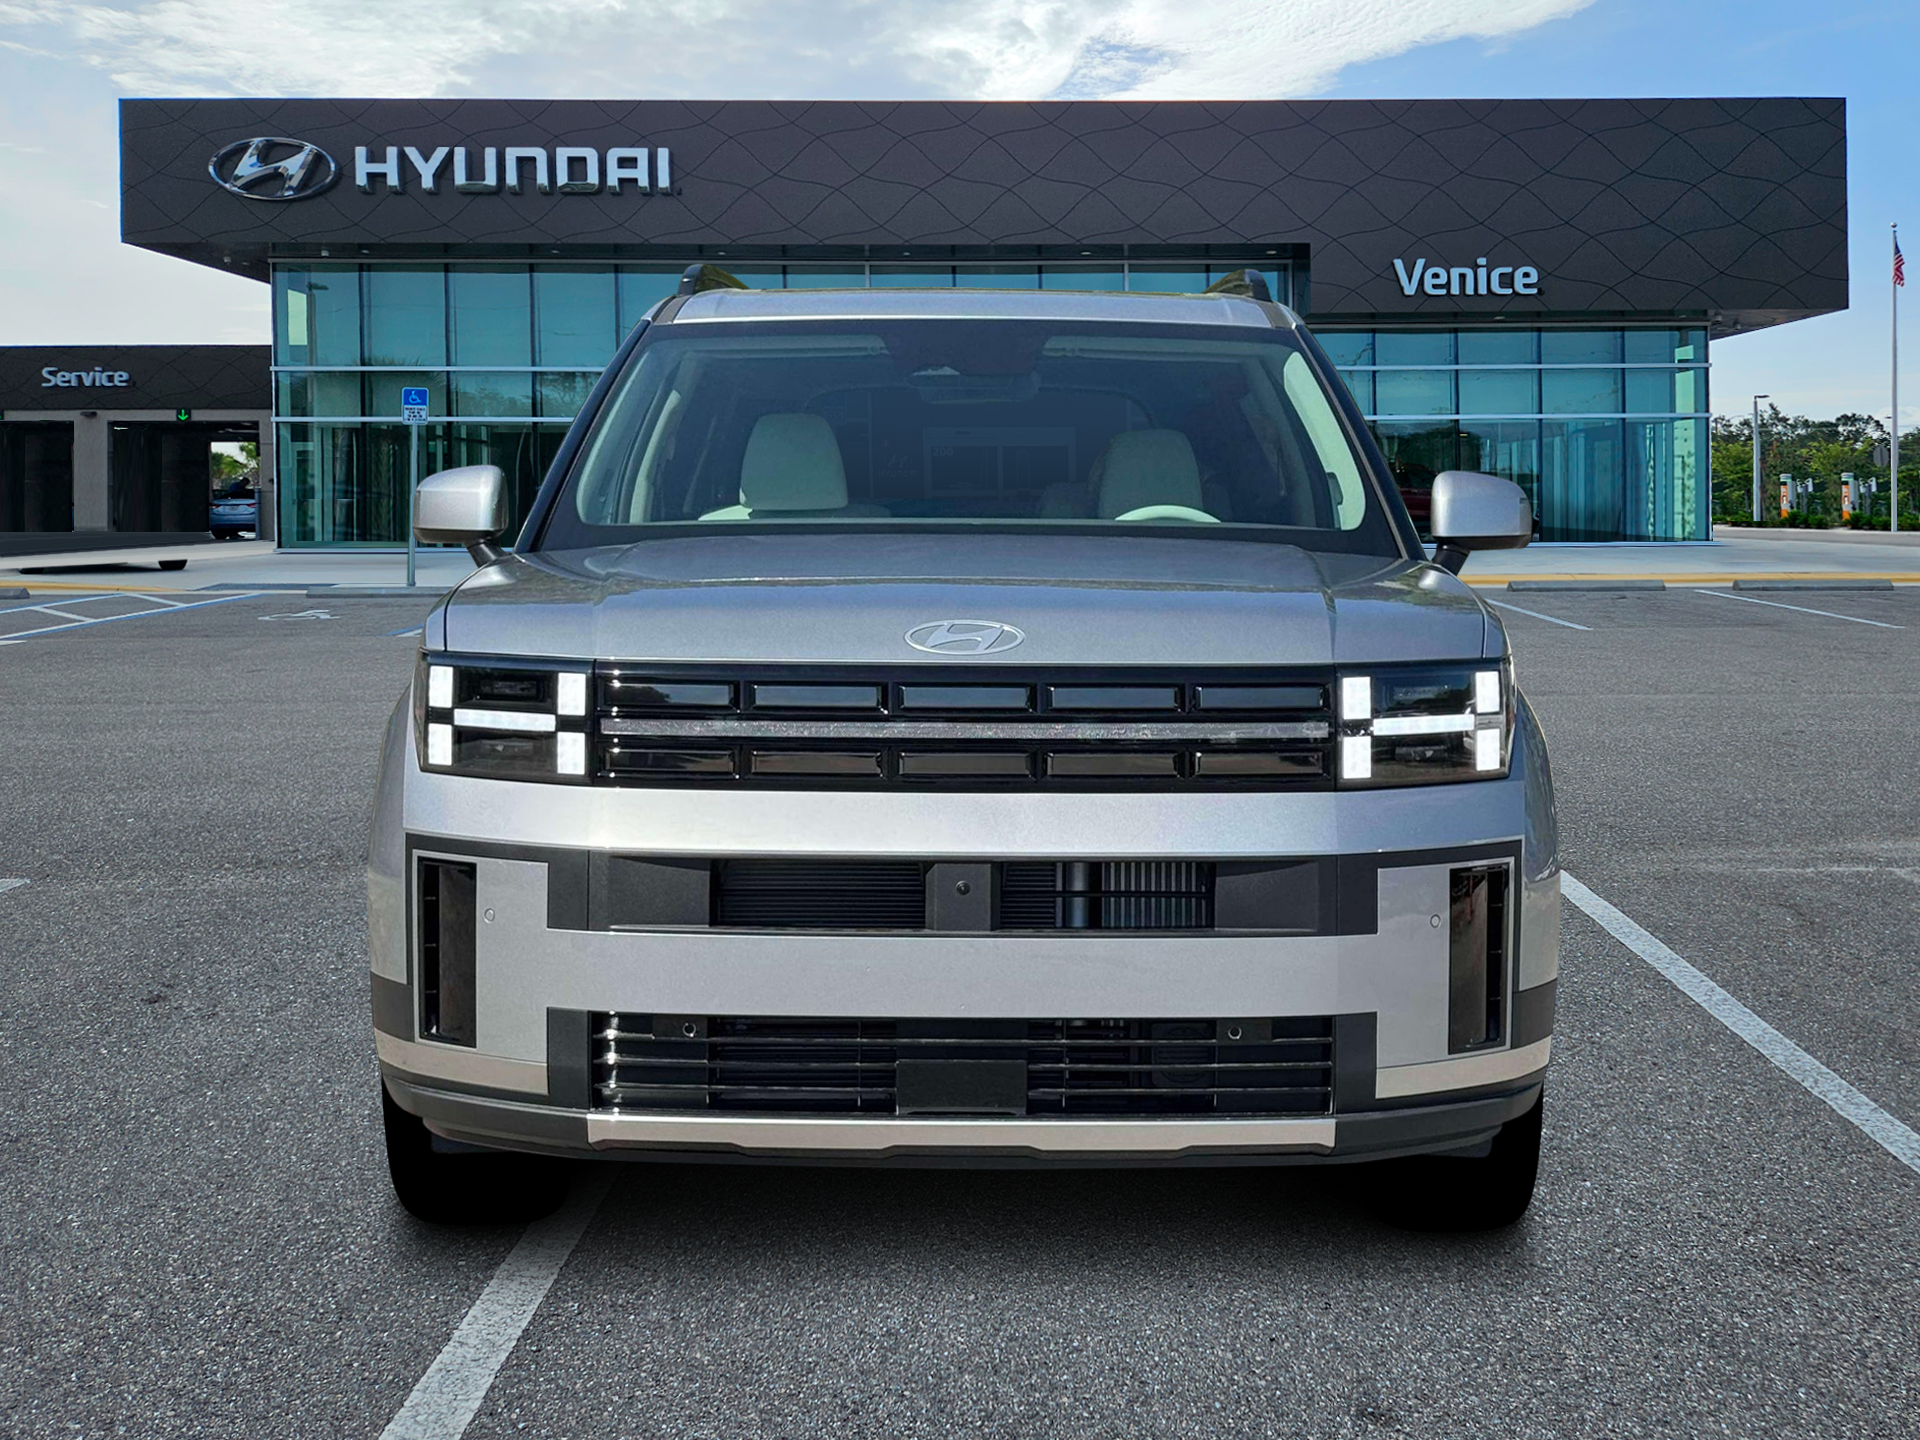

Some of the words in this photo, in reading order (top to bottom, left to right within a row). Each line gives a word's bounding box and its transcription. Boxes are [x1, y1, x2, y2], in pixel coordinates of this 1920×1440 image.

[354, 146, 672, 194] HYUNDAI
[1393, 257, 1539, 296] Venice
[41, 366, 130, 387] Service
